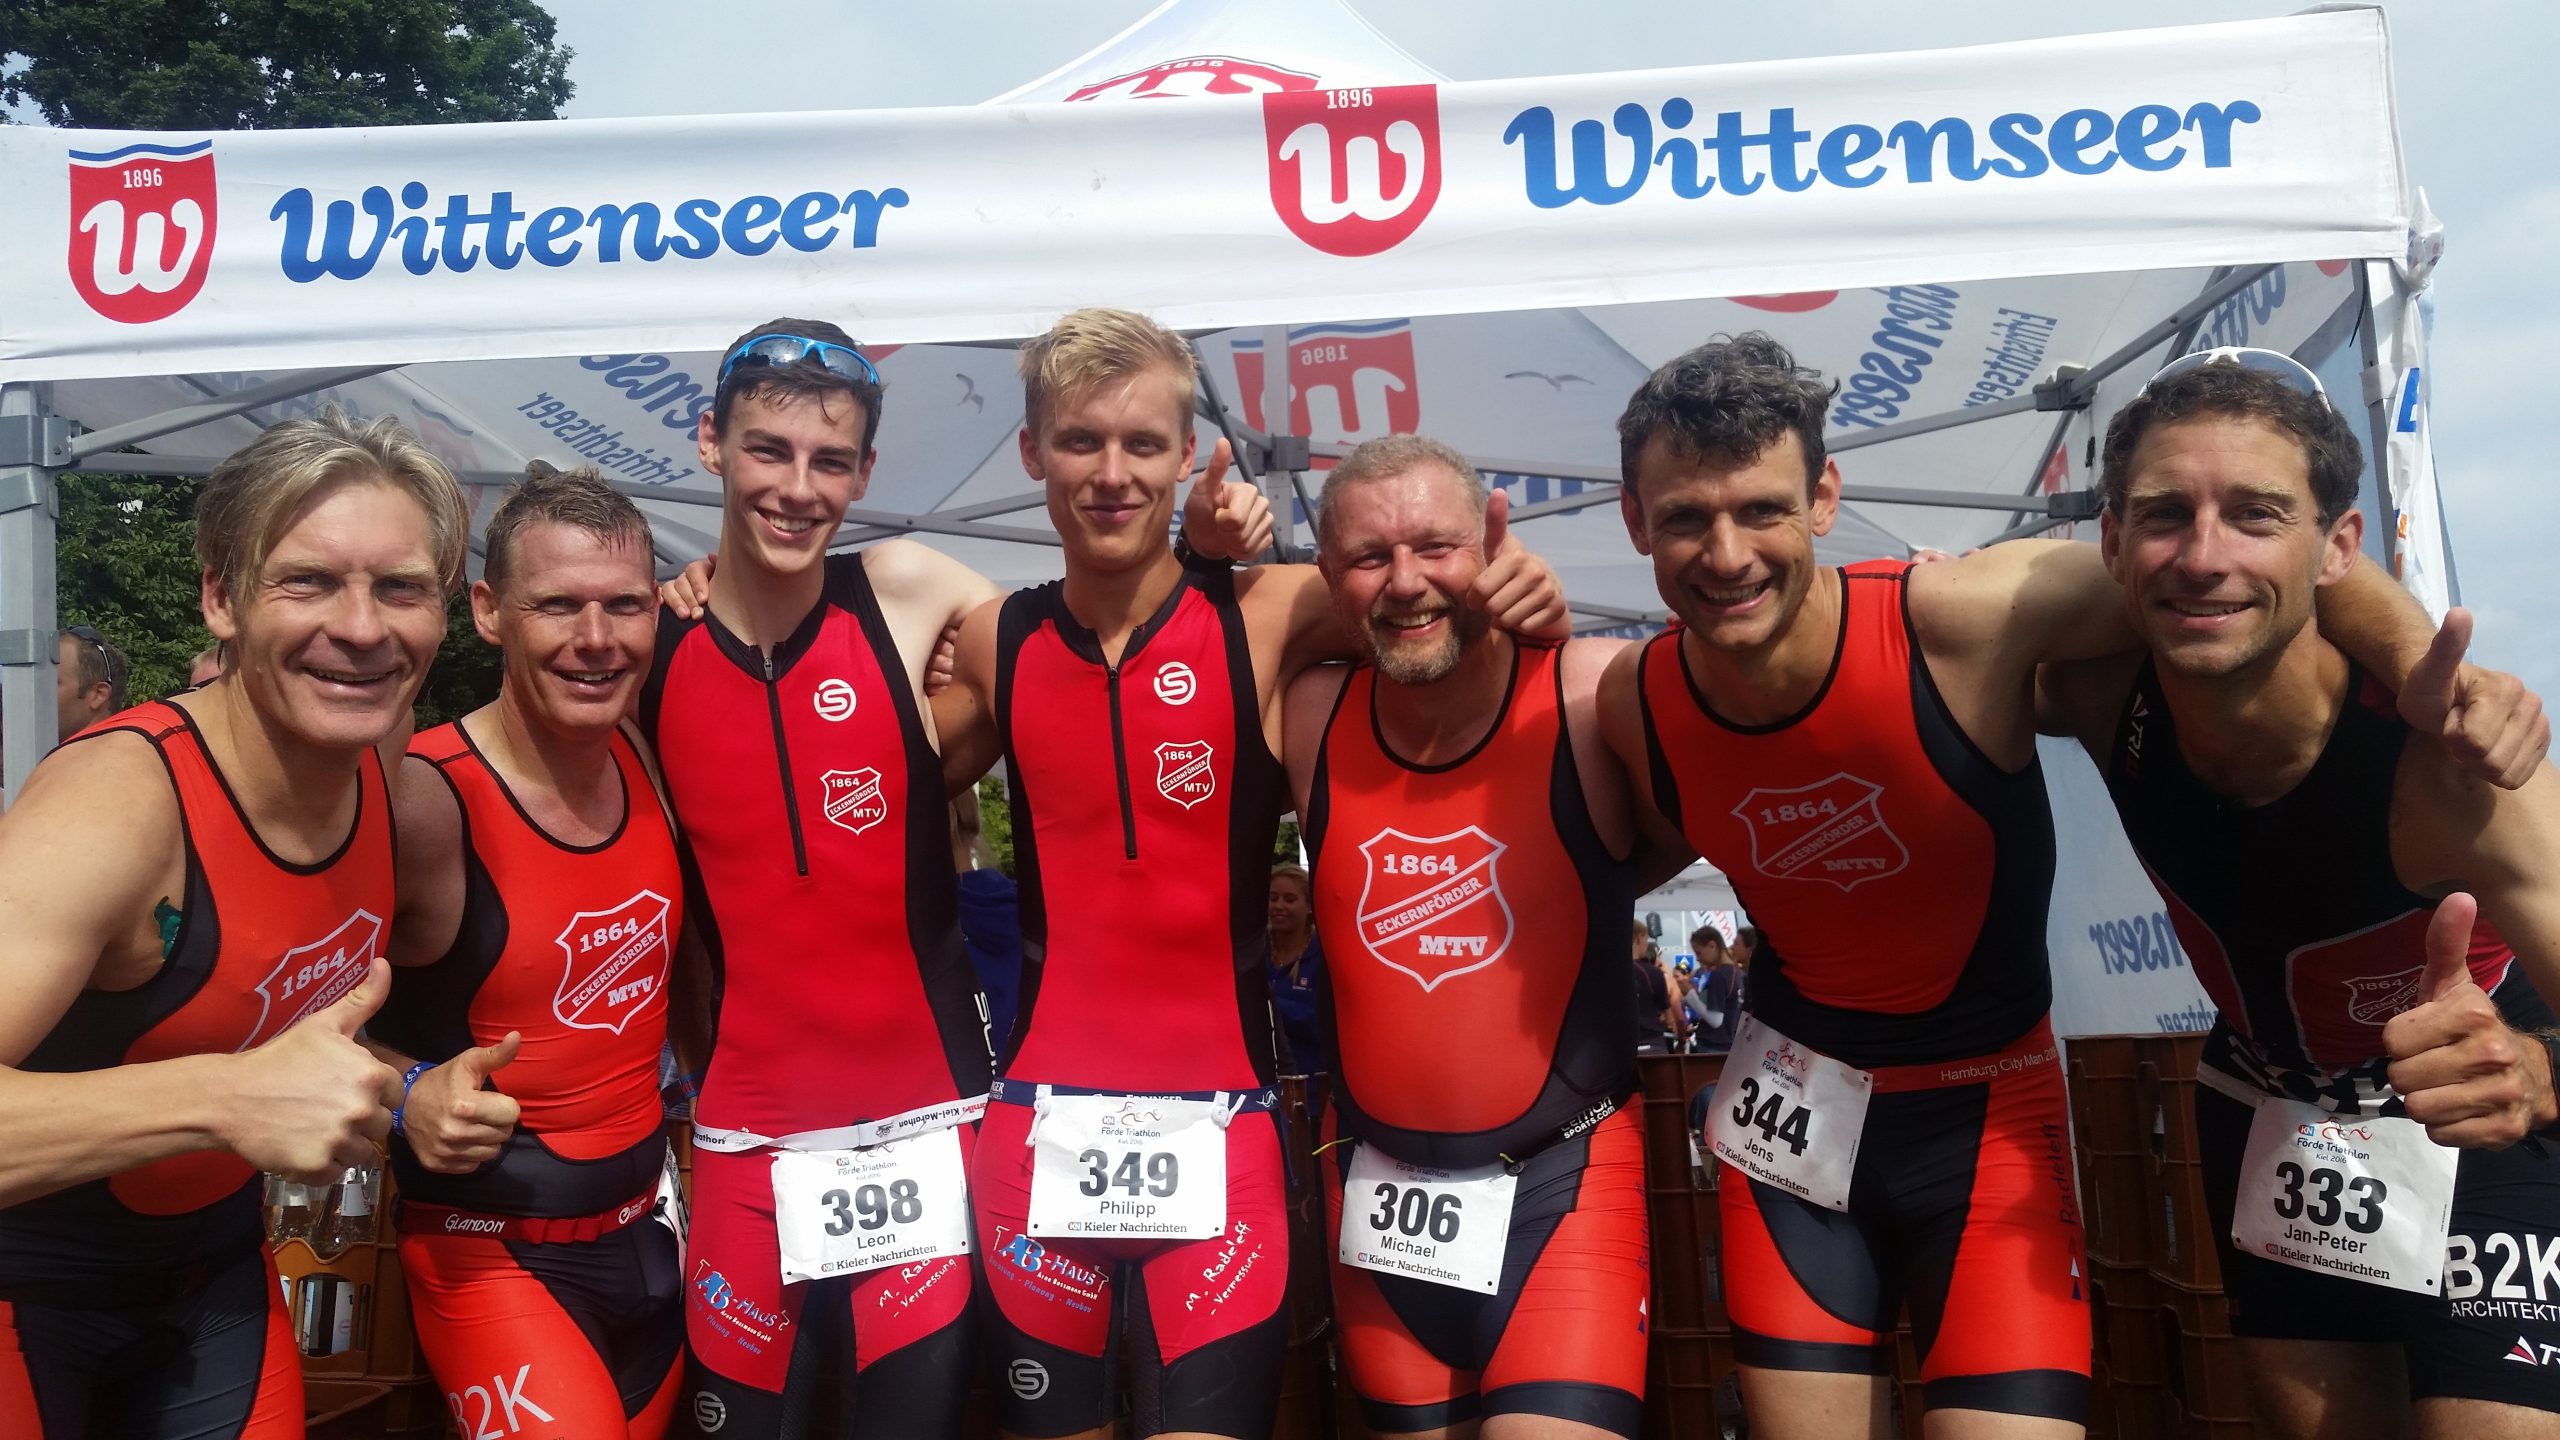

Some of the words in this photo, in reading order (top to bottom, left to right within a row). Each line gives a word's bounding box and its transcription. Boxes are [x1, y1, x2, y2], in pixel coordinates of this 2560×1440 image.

[1326, 88, 1373, 109] 1896
[1504, 97, 2262, 209] Wittenseer
[122, 168, 163, 190] 1896
[270, 181, 911, 284] Wittenseer
[1163, 750, 1193, 761] 1864
[830, 777, 860, 789] 1864
[1162, 760, 1206, 790] ECKERNFÖRDER
[1184, 783, 1211, 793] MTV
[829, 785, 876, 816] ECKERNFÖRDER
[852, 808, 882, 818] MTV
[1760, 798, 1838, 825] 1864
[1776, 814, 1868, 869] ECKERNFÖRDER
[1383, 854, 1458, 876] 1864
[1822, 858, 1886, 871] MTV
[1374, 877, 1484, 936] ECKERNFÖRDER
[579, 917, 639, 953] 1864
[1418, 935, 1488, 956] MTV
[280, 947, 346, 1001] 1864
[571, 931, 658, 1007] ECKERNFÖRDER
[607, 975, 654, 1007] MTV
[2357, 978, 2404, 991] 1864
[1762, 1060, 1780, 1075] Förde
[1780, 1068, 1804, 1089] Triathlon
[1941, 1063, 1998, 1081] Hamburg
[1999, 1057, 2023, 1072] City
[2023, 1053, 2044, 1067] Man
[898, 1107, 960, 1128] Kiel-Marathon
[1732, 1077, 1812, 1157] 344
[2298, 1124, 2315, 1137] KN
[1101, 1126, 1124, 1136] Förde
[1125, 1128, 1161, 1138] Triathlon
[1744, 1137, 1775, 1163] Jens
[2296, 1137, 2324, 1151] Förde
[2326, 1141, 2370, 1160] Triathlon
[2316, 1153, 2329, 1161] Kiel
[837, 1165, 860, 1175] Förde
[861, 1161, 897, 1173] Triathlon
[1079, 1149, 1179, 1198] 349
[1724, 1146, 1749, 1168] Kieler
[1748, 1160, 1810, 1196] Nachrichten
[821, 1178, 923, 1237] 398
[1100, 1201, 1156, 1217] Philipp
[2273, 1161, 2387, 1234] 333
[444, 1213, 505, 1233] GLANDON
[1369, 1182, 1463, 1243] 306
[1084, 1222, 1117, 1233] Kieler
[1120, 1223, 1187, 1233] Nachrichten
[2284, 1223, 2367, 1255] Jan-Peter
[857, 1233, 896, 1250] Leon
[1380, 1235, 1436, 1259] Michael
[836, 1255, 869, 1270] Kieler
[871, 1244, 937, 1264] Nachrichten
[1368, 1253, 1396, 1269] Kieler
[1397, 1259, 1461, 1282] Nachrichten
[2280, 1246, 2311, 1264] Kieler
[2312, 1250, 2391, 1281] Nachrichten
[2444, 1231, 2560, 1301] B2K
[900, 1258, 957, 1308] Vermessung
[1213, 1251, 1264, 1304] Vermessung
[2451, 1300, 2560, 1322] ARCHITEKT
